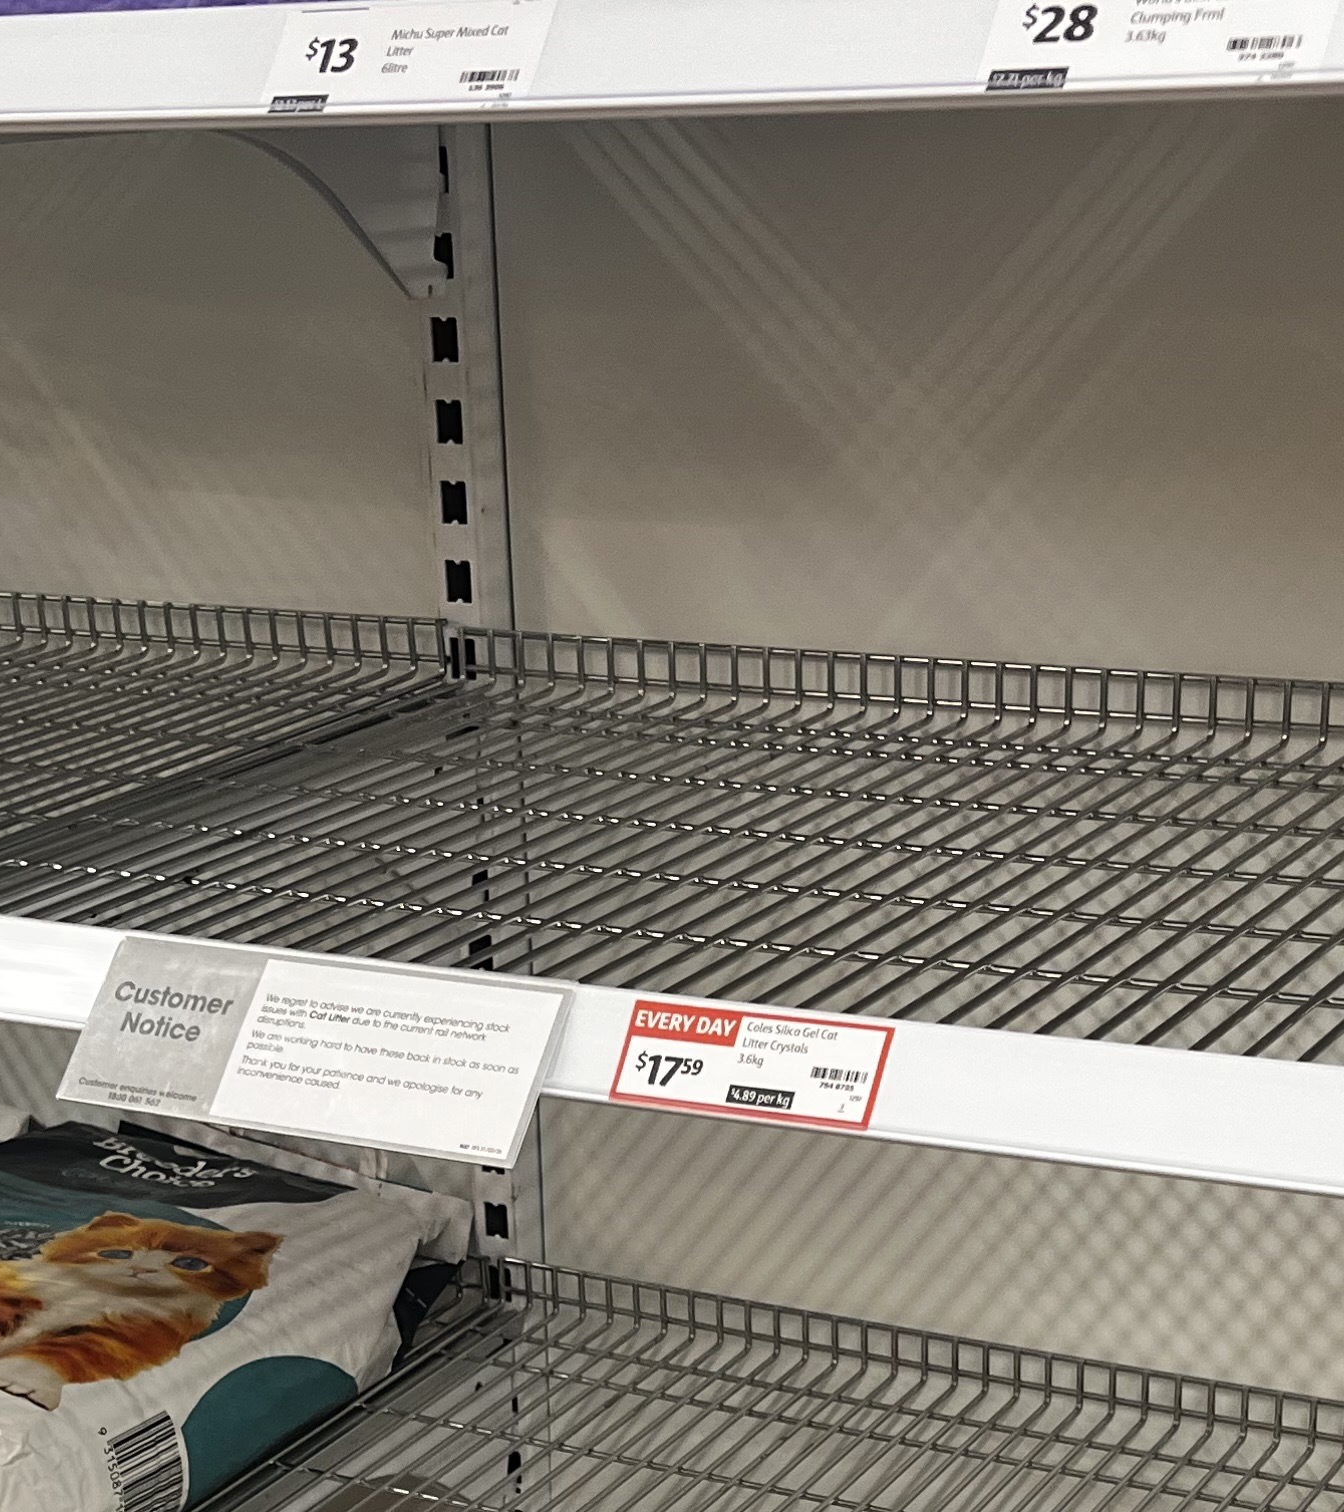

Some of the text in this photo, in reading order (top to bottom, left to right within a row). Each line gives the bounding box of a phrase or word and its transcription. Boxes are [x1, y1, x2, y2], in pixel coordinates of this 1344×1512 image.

[391, 25, 509, 41] Michu Super Mixed Cat
[1022, 3, 1098, 44] $28
[306, 37, 358, 73] $13
[387, 46, 413, 56] Litter
[115, 980, 235, 1017] Customer
[120, 1013, 201, 1043] Notice
[261, 1005, 487, 1040] issues with Cat Litter due to the current rail network
[267, 994, 510, 1033] We regret to advise we are currently experiencing stock
[635, 1009, 736, 1038] EVERY DAY
[742, 1037, 808, 1054] Litter Crystals
[747, 1022, 838, 1041] Coles Silica Gel Cat
[737, 1053, 764, 1068] 3.6kg
[731, 1088, 790, 1108] $4.89 per kg
